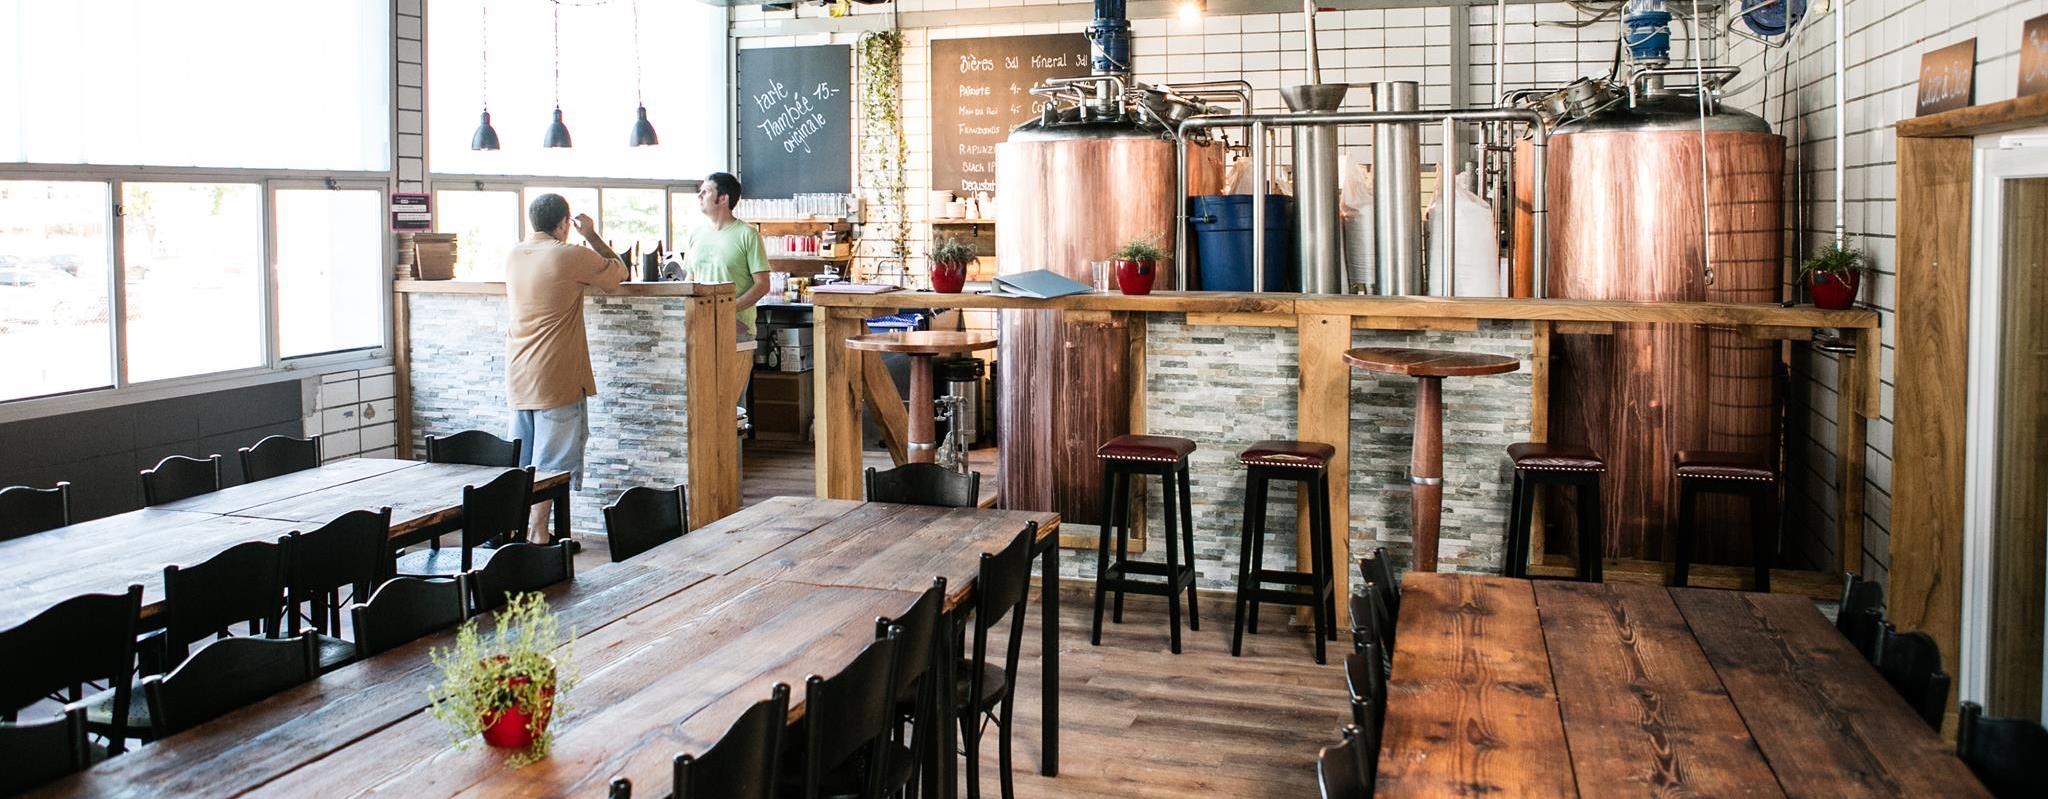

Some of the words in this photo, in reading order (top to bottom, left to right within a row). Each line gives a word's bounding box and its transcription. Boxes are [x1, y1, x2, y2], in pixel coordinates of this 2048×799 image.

[960, 53, 994, 73] Bières
[783, 112, 827, 154] originale
[959, 143, 996, 155] RAPUNZ
